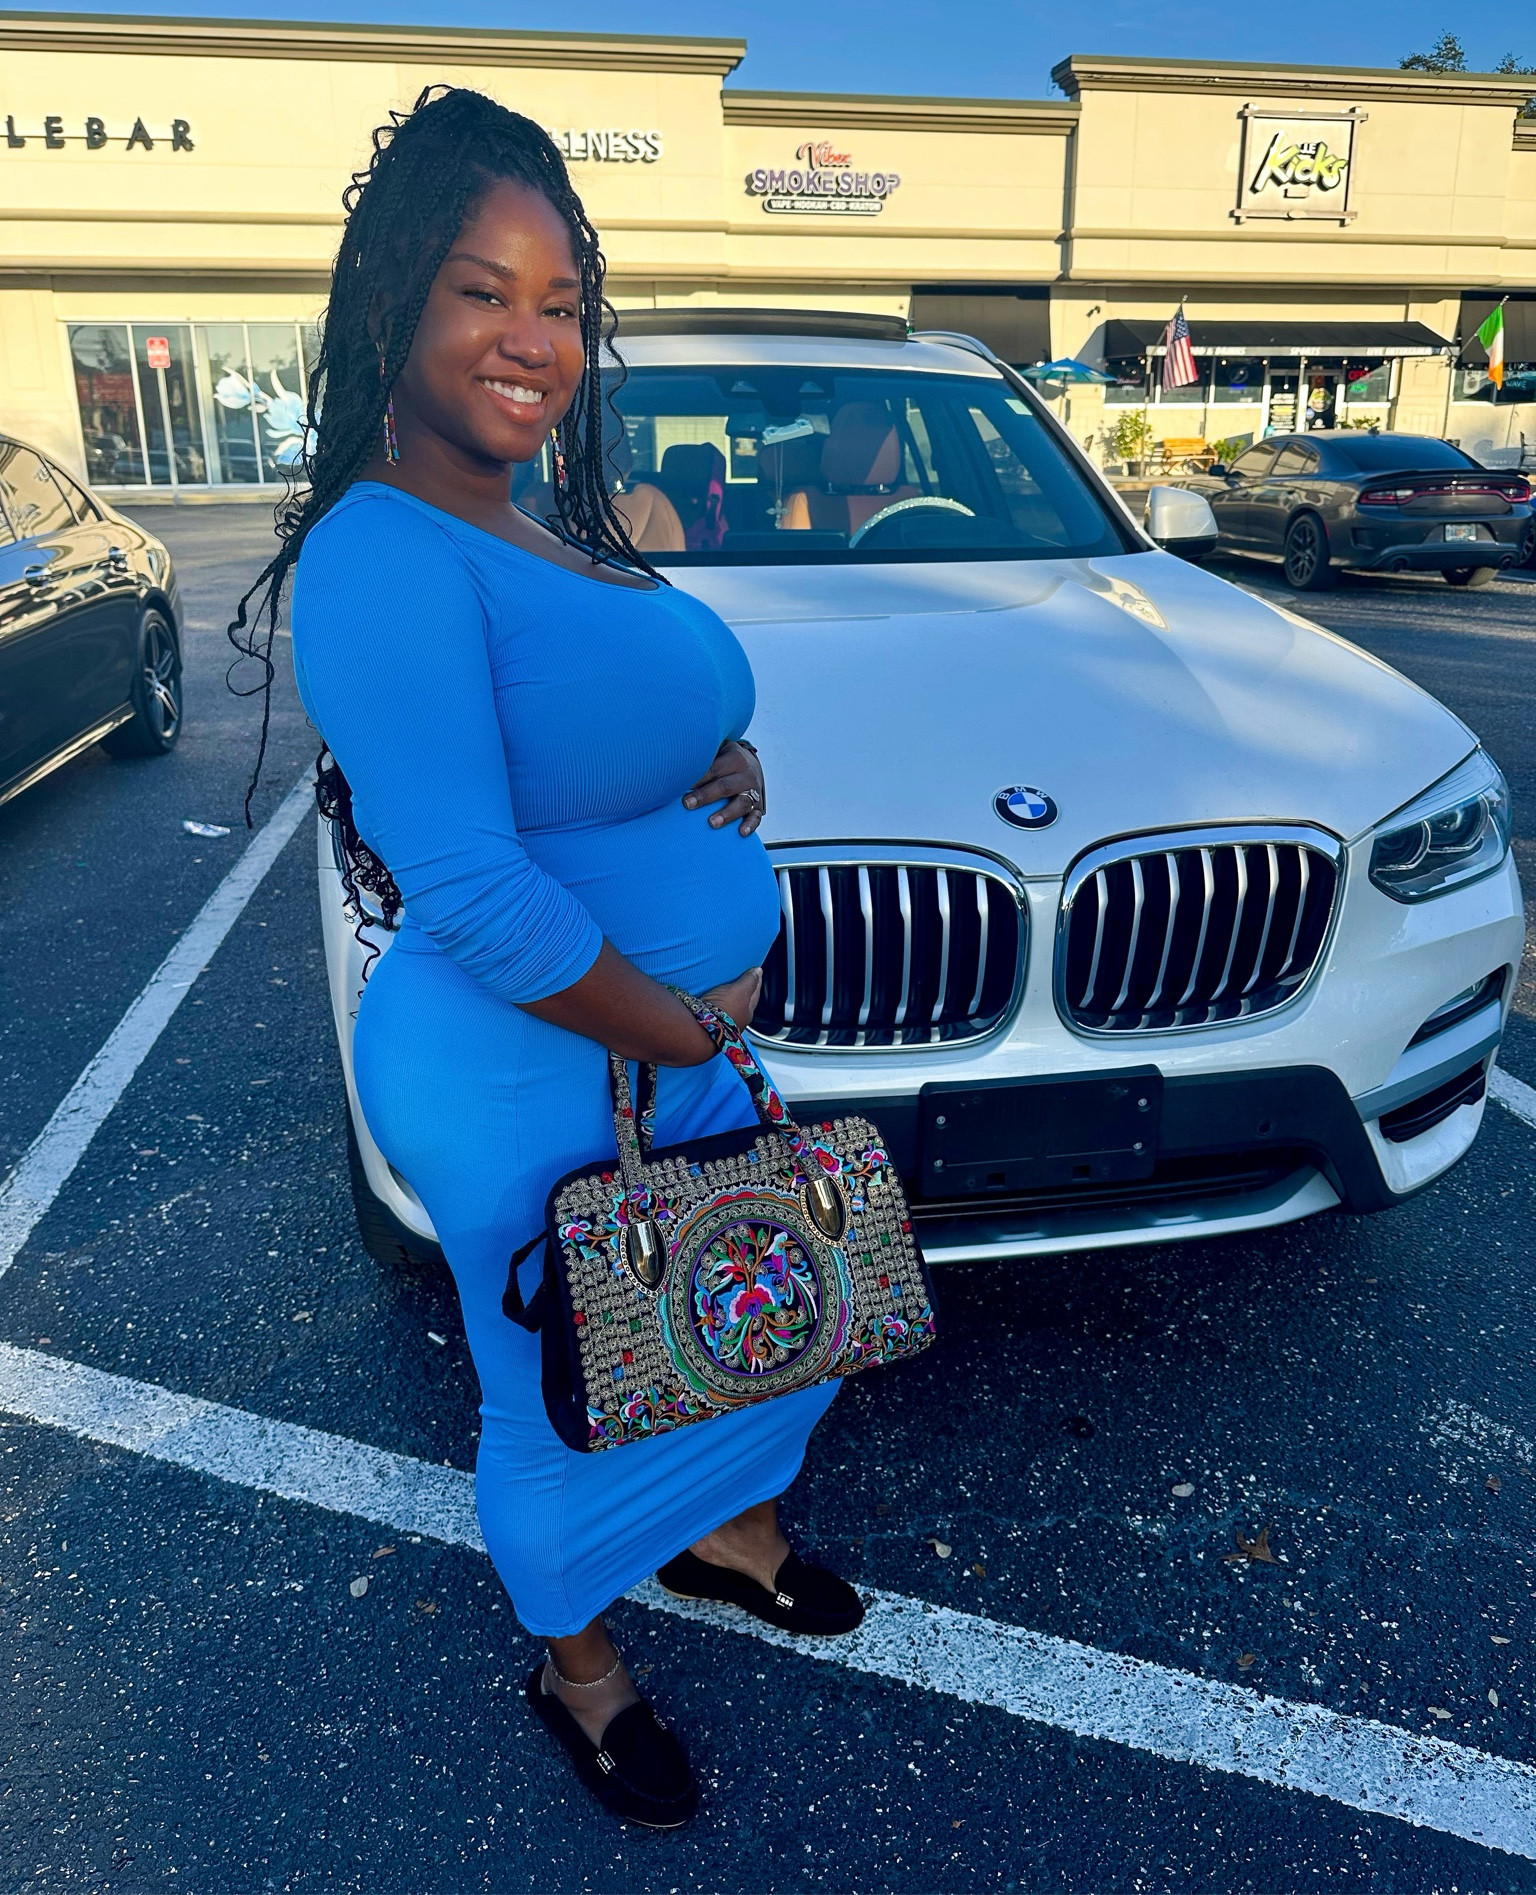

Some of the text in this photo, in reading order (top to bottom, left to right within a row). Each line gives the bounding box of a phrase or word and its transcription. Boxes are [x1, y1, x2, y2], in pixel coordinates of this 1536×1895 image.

[1300, 142, 1318, 155] LE
[1250, 130, 1348, 194] Kicks
[752, 168, 901, 198] SMOKE SHOP
[998, 785, 1048, 800] BMW
